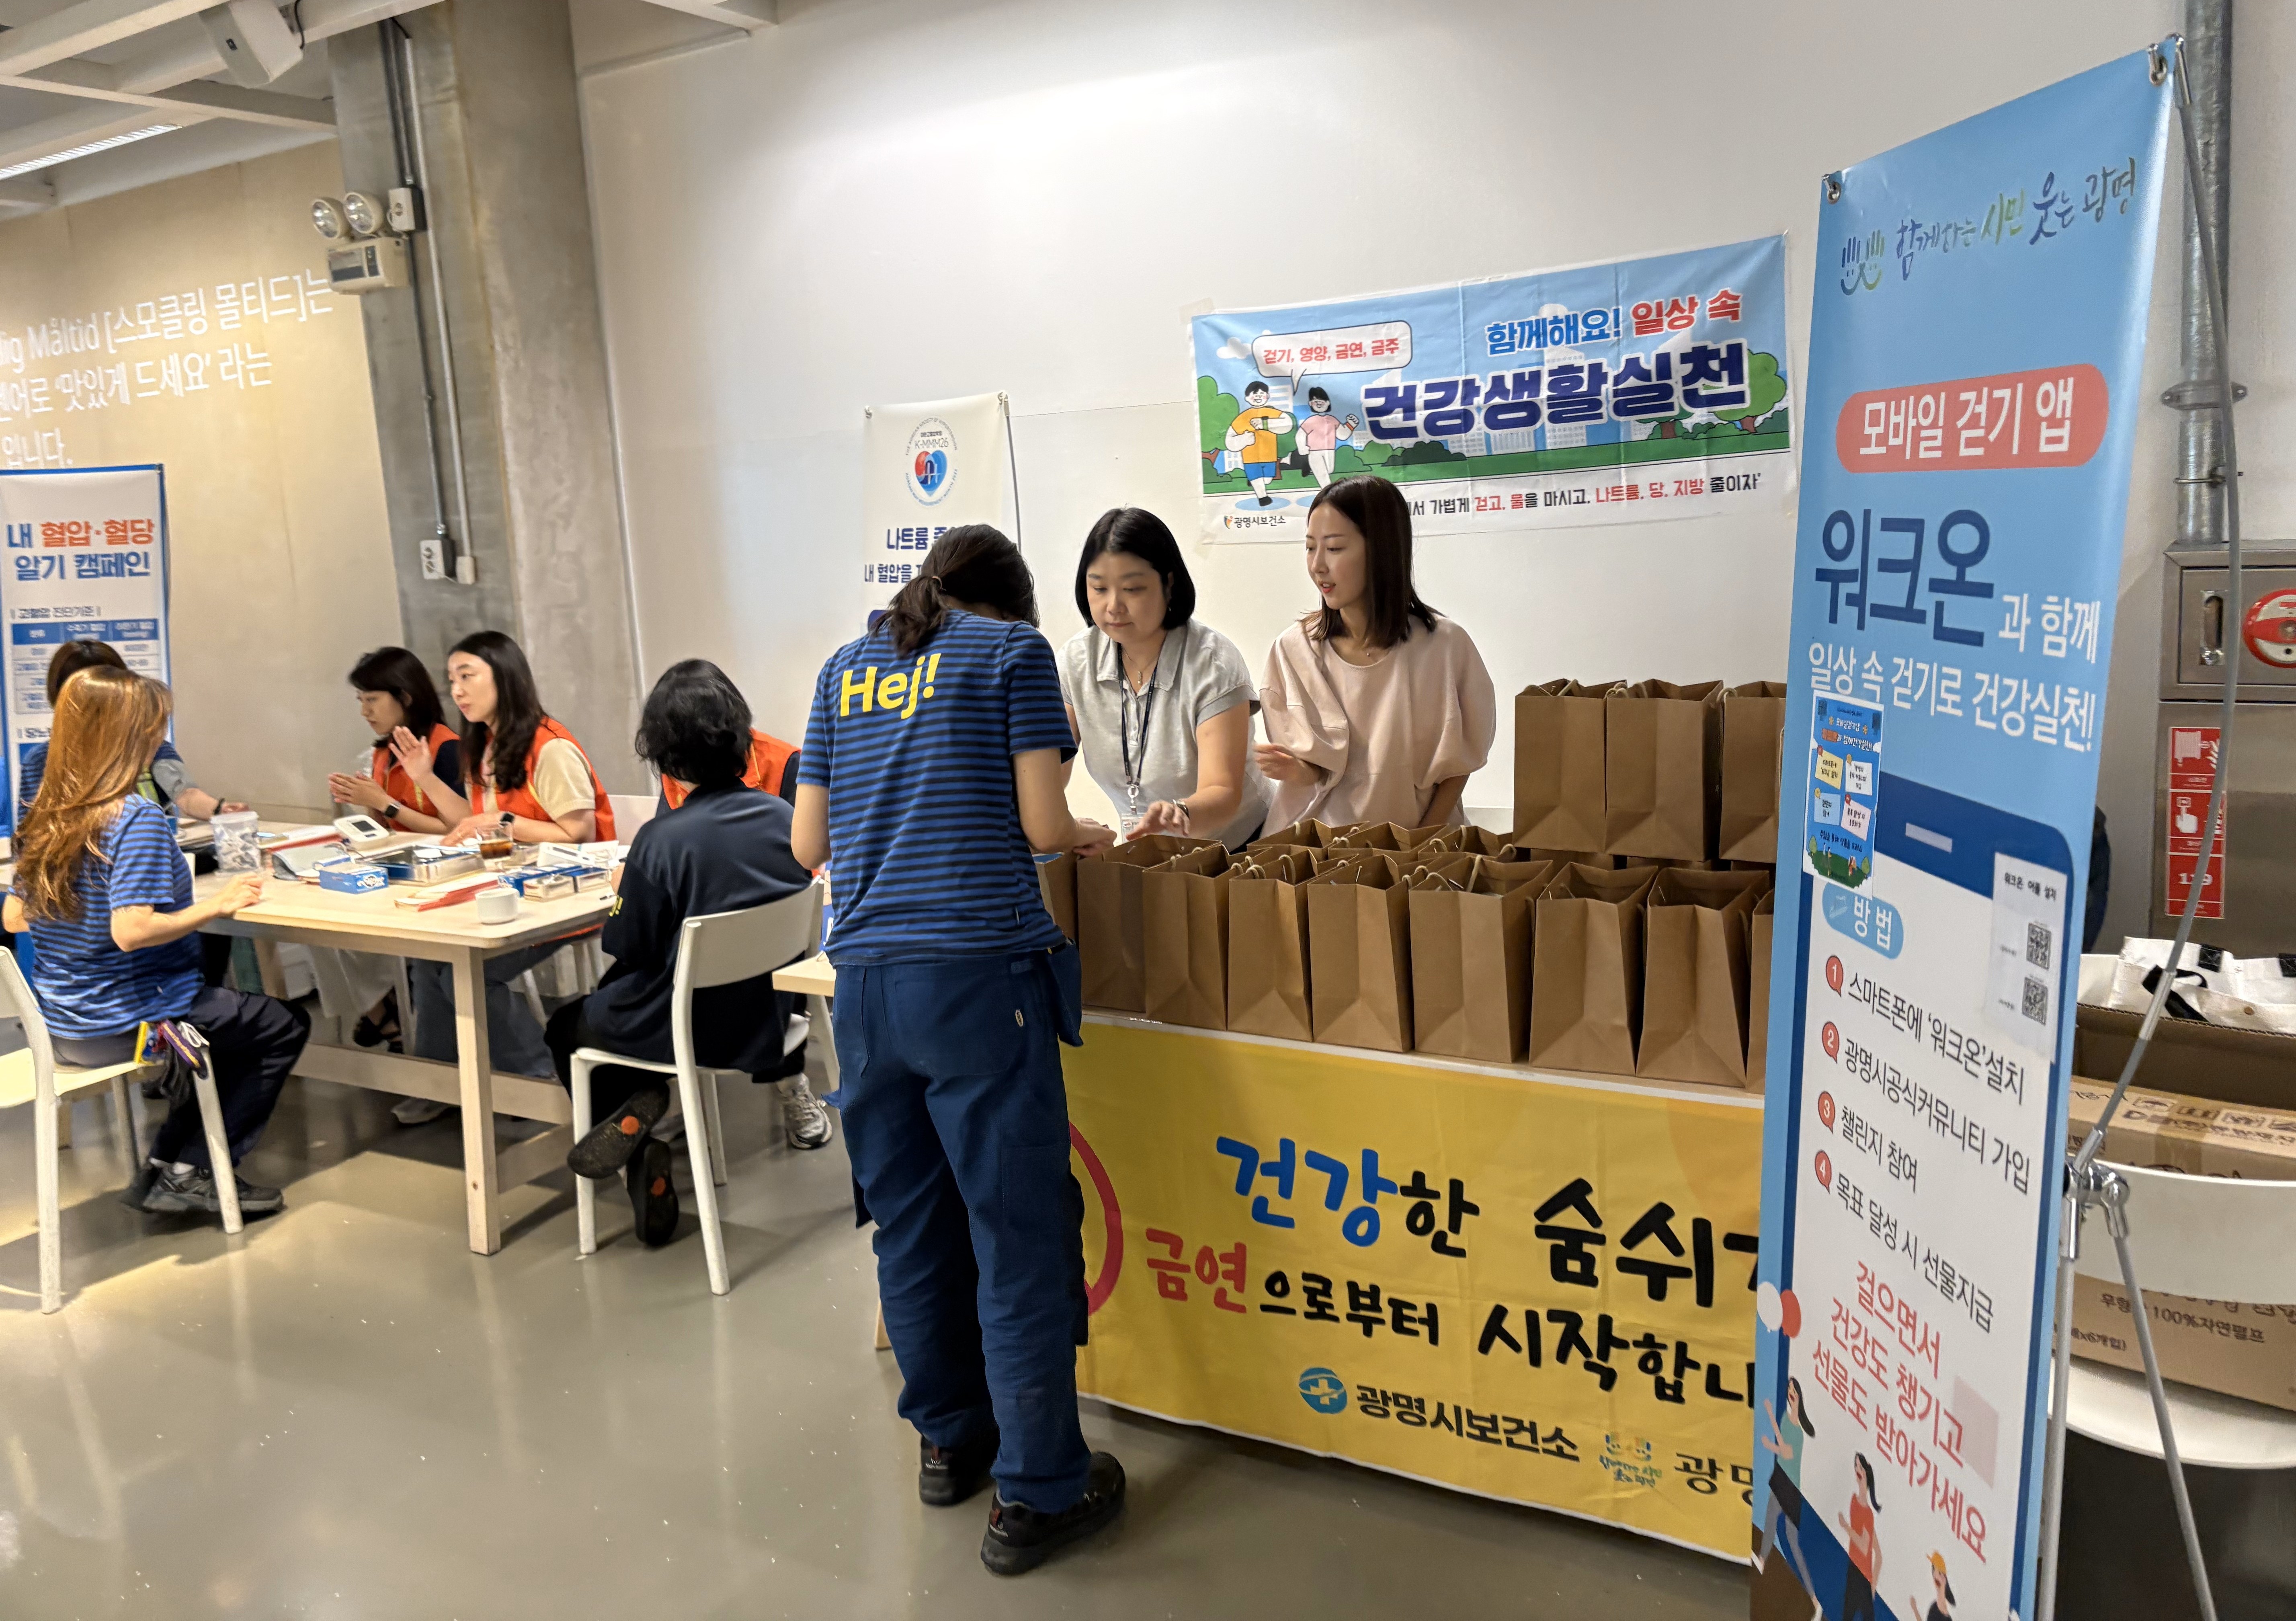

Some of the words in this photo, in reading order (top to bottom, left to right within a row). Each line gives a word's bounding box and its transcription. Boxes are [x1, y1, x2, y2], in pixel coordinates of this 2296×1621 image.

[1896, 218, 1976, 281] 함께하는
[1980, 187, 2025, 246] 시민
[2029, 172, 2075, 246] 웃는
[2082, 156, 2135, 223] 광명
[215, 269, 334, 330] 몰티드]는
[1487, 307, 1622, 355] 함께해요!
[1631, 296, 1698, 336] 일상
[1708, 289, 1742, 321] 속
[218, 343, 273, 390] 라는
[1263, 349, 1294, 364] 걷기,
[1300, 346, 1331, 362] 영양,
[1335, 342, 1367, 359] 금연,
[1371, 338, 1399, 356] 금주
[1364, 342, 1747, 441] 건강생활실천
[1859, 392, 1945, 460] 모바일
[1956, 383, 2023, 456] 걷기
[2036, 377, 2074, 453] 앱
[1234, 515, 1287, 528] 광명시보건소
[1430, 497, 1470, 515] 가볍게
[1511, 492, 1538, 509] 물을
[1673, 478, 1705, 496] 지방
[7, 523, 34, 548] 내
[14, 554, 66, 581] 알기
[74, 551, 150, 579] 캠페인
[887, 527, 929, 550] 나트륨
[864, 564, 874, 583] 내
[877, 563, 912, 583] 혈압을
[2041, 595, 2101, 664] 함께
[840, 653, 942, 719] Hej!
[1808, 642, 1856, 696] 일상
[1861, 650, 1884, 703] 속
[1891, 657, 1963, 716] 걷기로
[1972, 672, 2096, 752] 건강실천!
[2178, 872, 2213, 885] 19
[1848, 972, 1923, 1043] 스마트폰에
[1841, 1105, 1883, 1166] 챌린지
[1888, 1141, 1918, 1194] 참여
[1992, 1137, 2030, 1196] 가입
[1216, 1136, 1480, 1258] 건강한
[1145, 1228, 1439, 1346] 금연으로부터
[1836, 1173, 1864, 1220] 목표
[1869, 1199, 1897, 1251] 달성
[1902, 1231, 1917, 1270] 시
[1923, 1247, 1994, 1334] 선물지급
[1856, 1260, 1940, 1379] 걸으면서
[1831, 1297, 1889, 1389] 건강도
[1896, 1362, 1964, 1468] 챙기고
[1356, 1384, 1580, 1463] 광명시보건소
[1812, 1340, 1868, 1432] 선물도
[1875, 1403, 1986, 1564] 받아가세요
